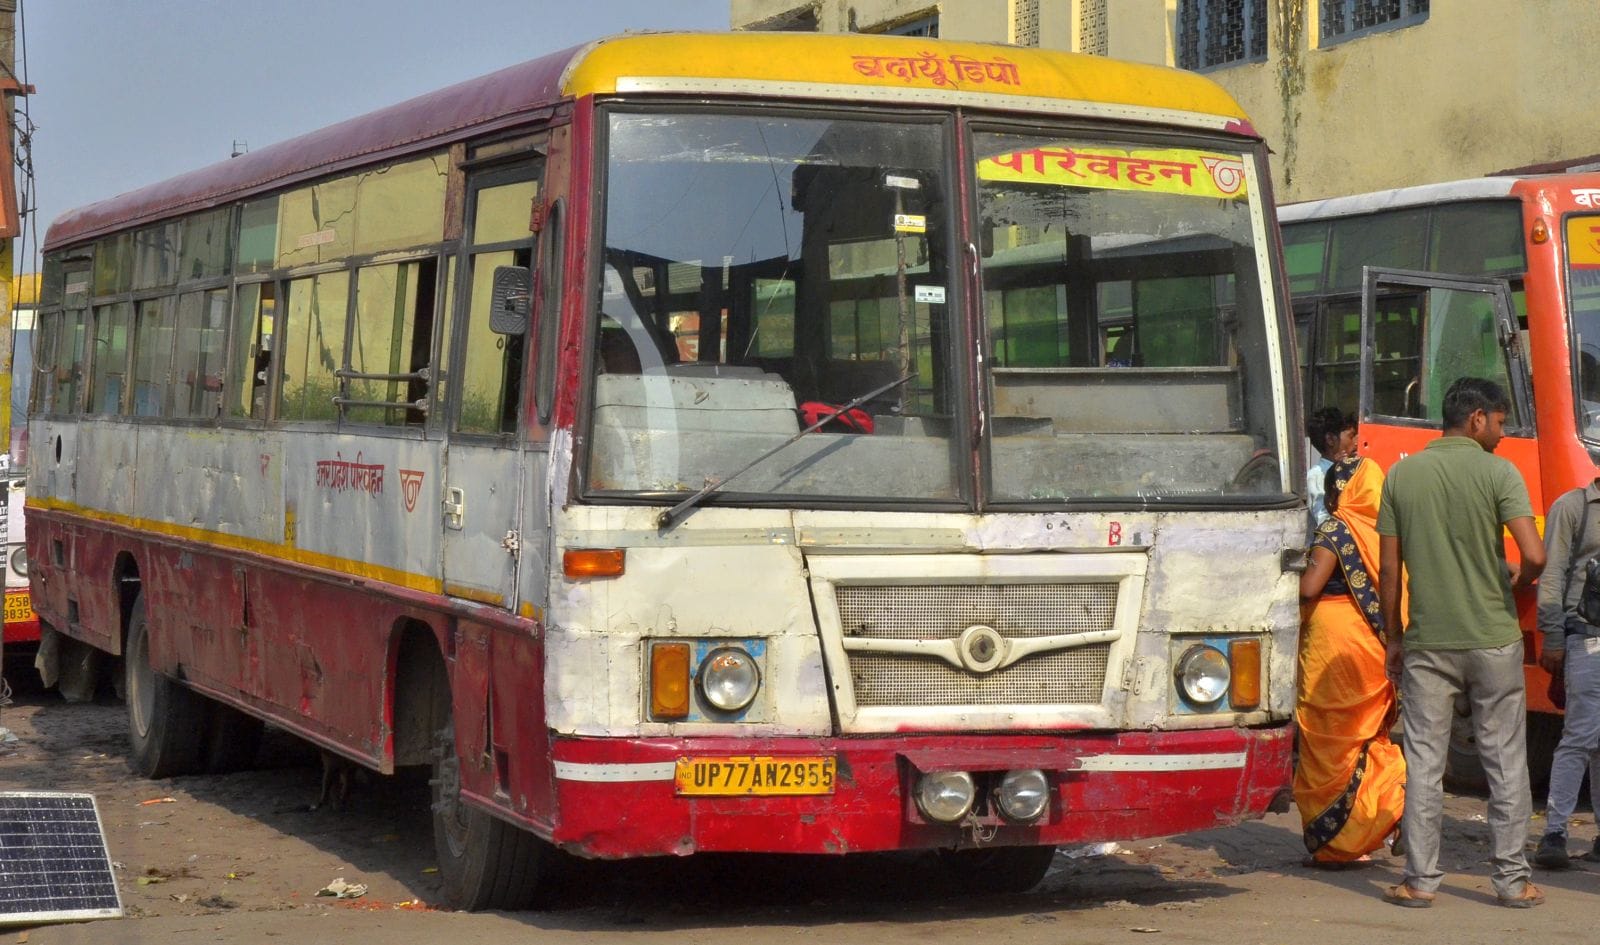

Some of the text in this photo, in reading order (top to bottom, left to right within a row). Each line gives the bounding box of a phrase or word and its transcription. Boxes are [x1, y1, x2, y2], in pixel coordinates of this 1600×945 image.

[949, 55, 1021, 86] डिपो
[351, 450, 385, 499] परिवहन
[694, 763, 834, 788] UP77AN2955
